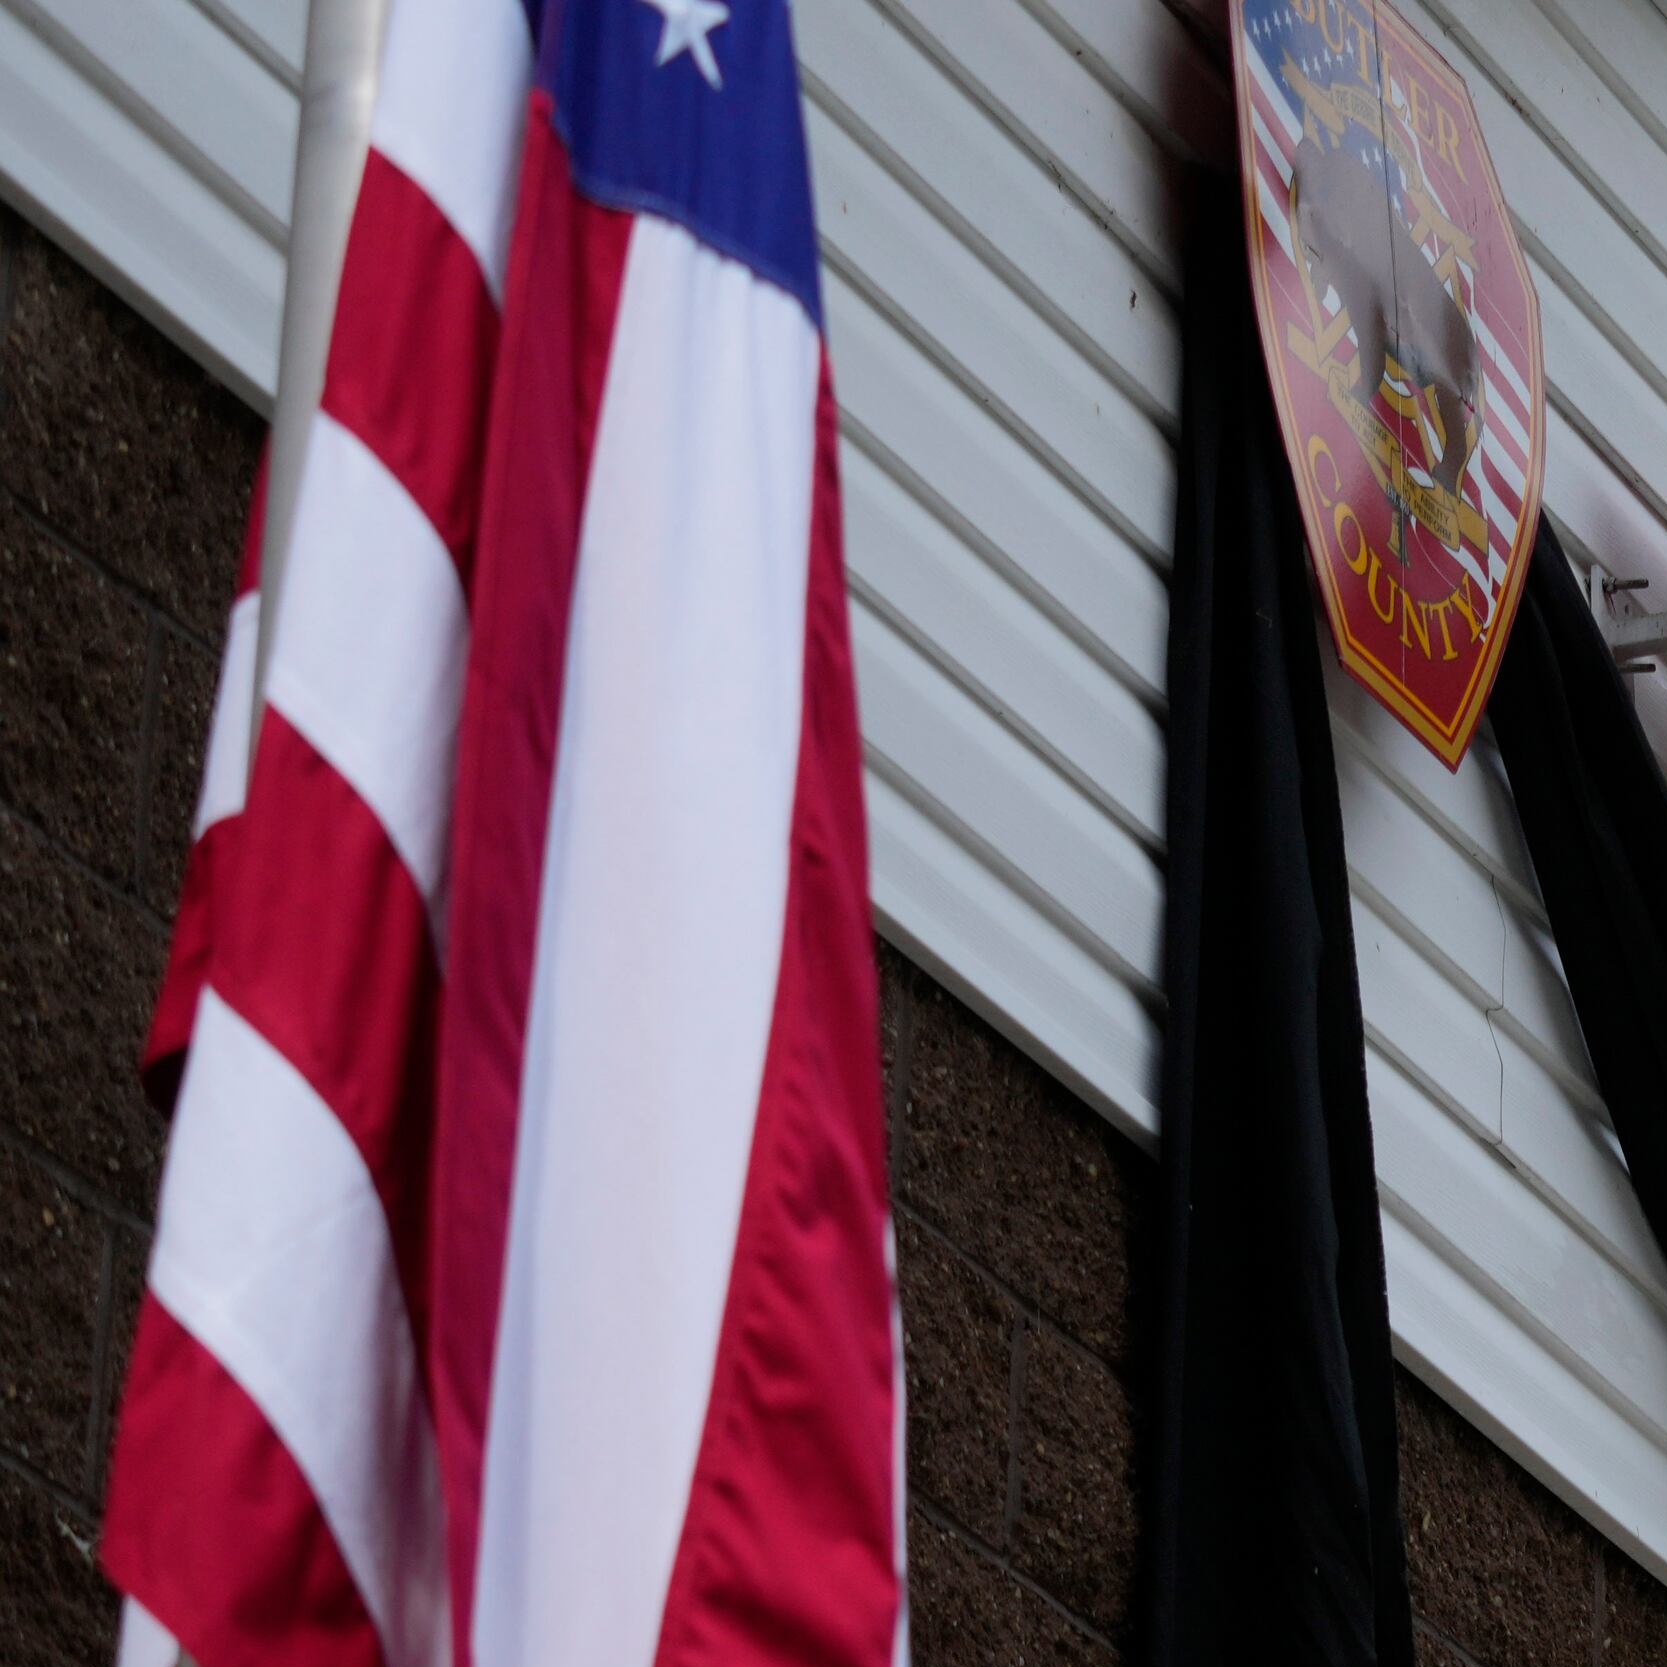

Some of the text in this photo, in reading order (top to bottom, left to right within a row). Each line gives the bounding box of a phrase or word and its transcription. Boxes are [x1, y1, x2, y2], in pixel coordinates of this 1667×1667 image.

[1413, 499, 1453, 542] PERFORM
[1419, 491, 1451, 525] ABILITY
[1307, 433, 1484, 661] COUNTY
